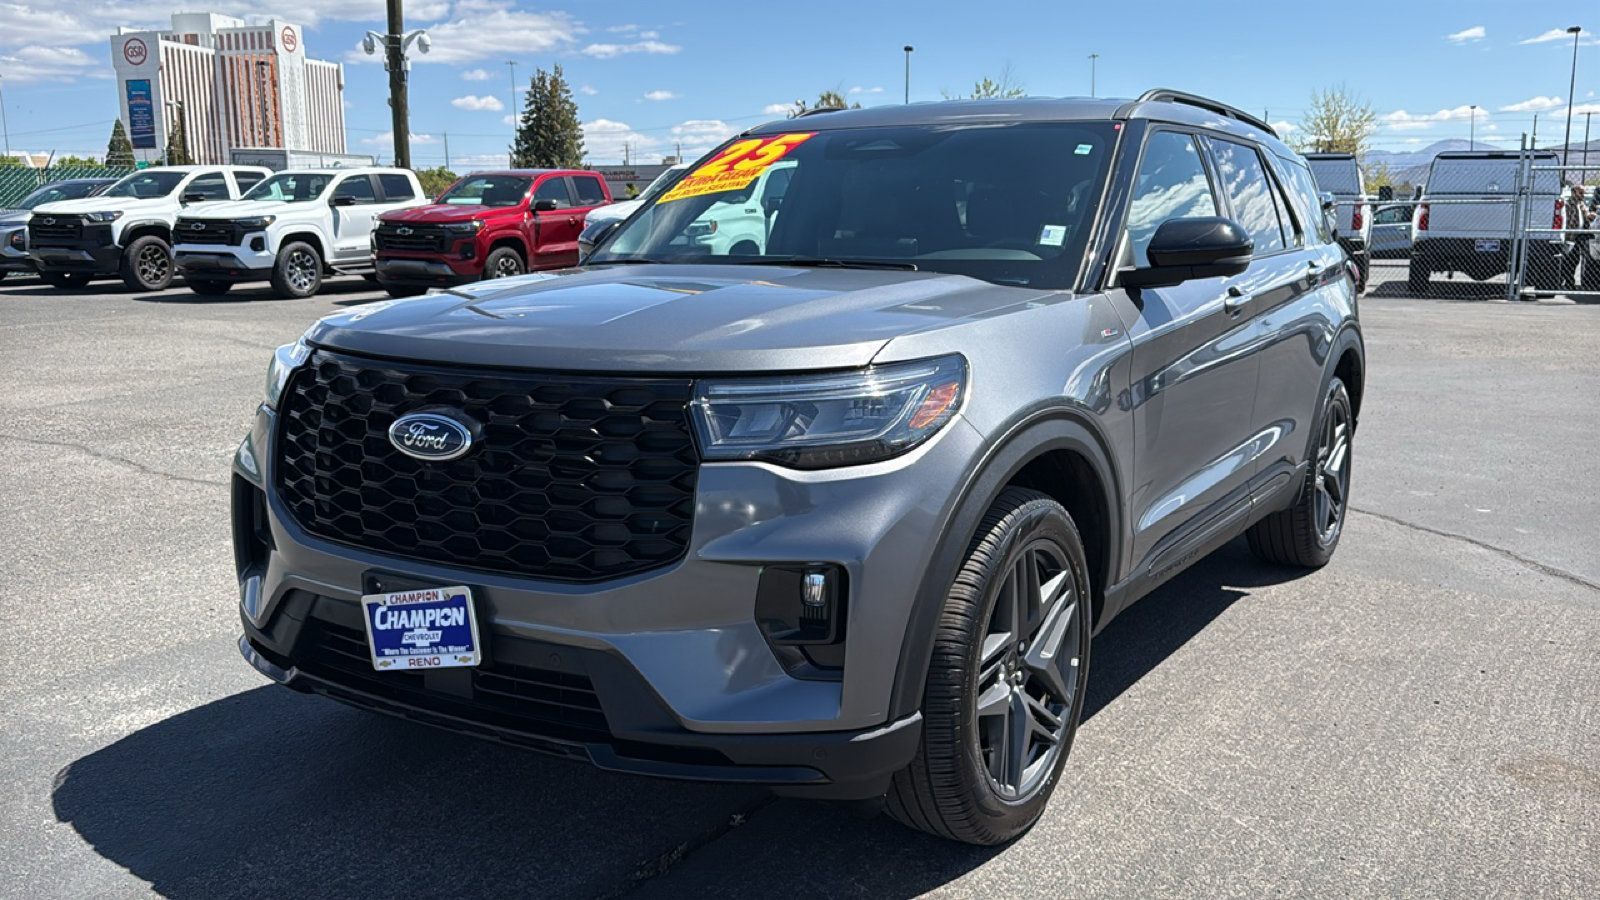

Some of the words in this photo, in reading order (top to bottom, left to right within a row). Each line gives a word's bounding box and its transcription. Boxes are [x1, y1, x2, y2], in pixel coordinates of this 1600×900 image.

[128, 45, 145, 57] GSR
[691, 132, 813, 178] 25
[404, 422, 449, 449] Ford
[389, 591, 439, 605] CHAMPION
[374, 606, 465, 631] CHAMPION
[408, 656, 441, 667] RENO
